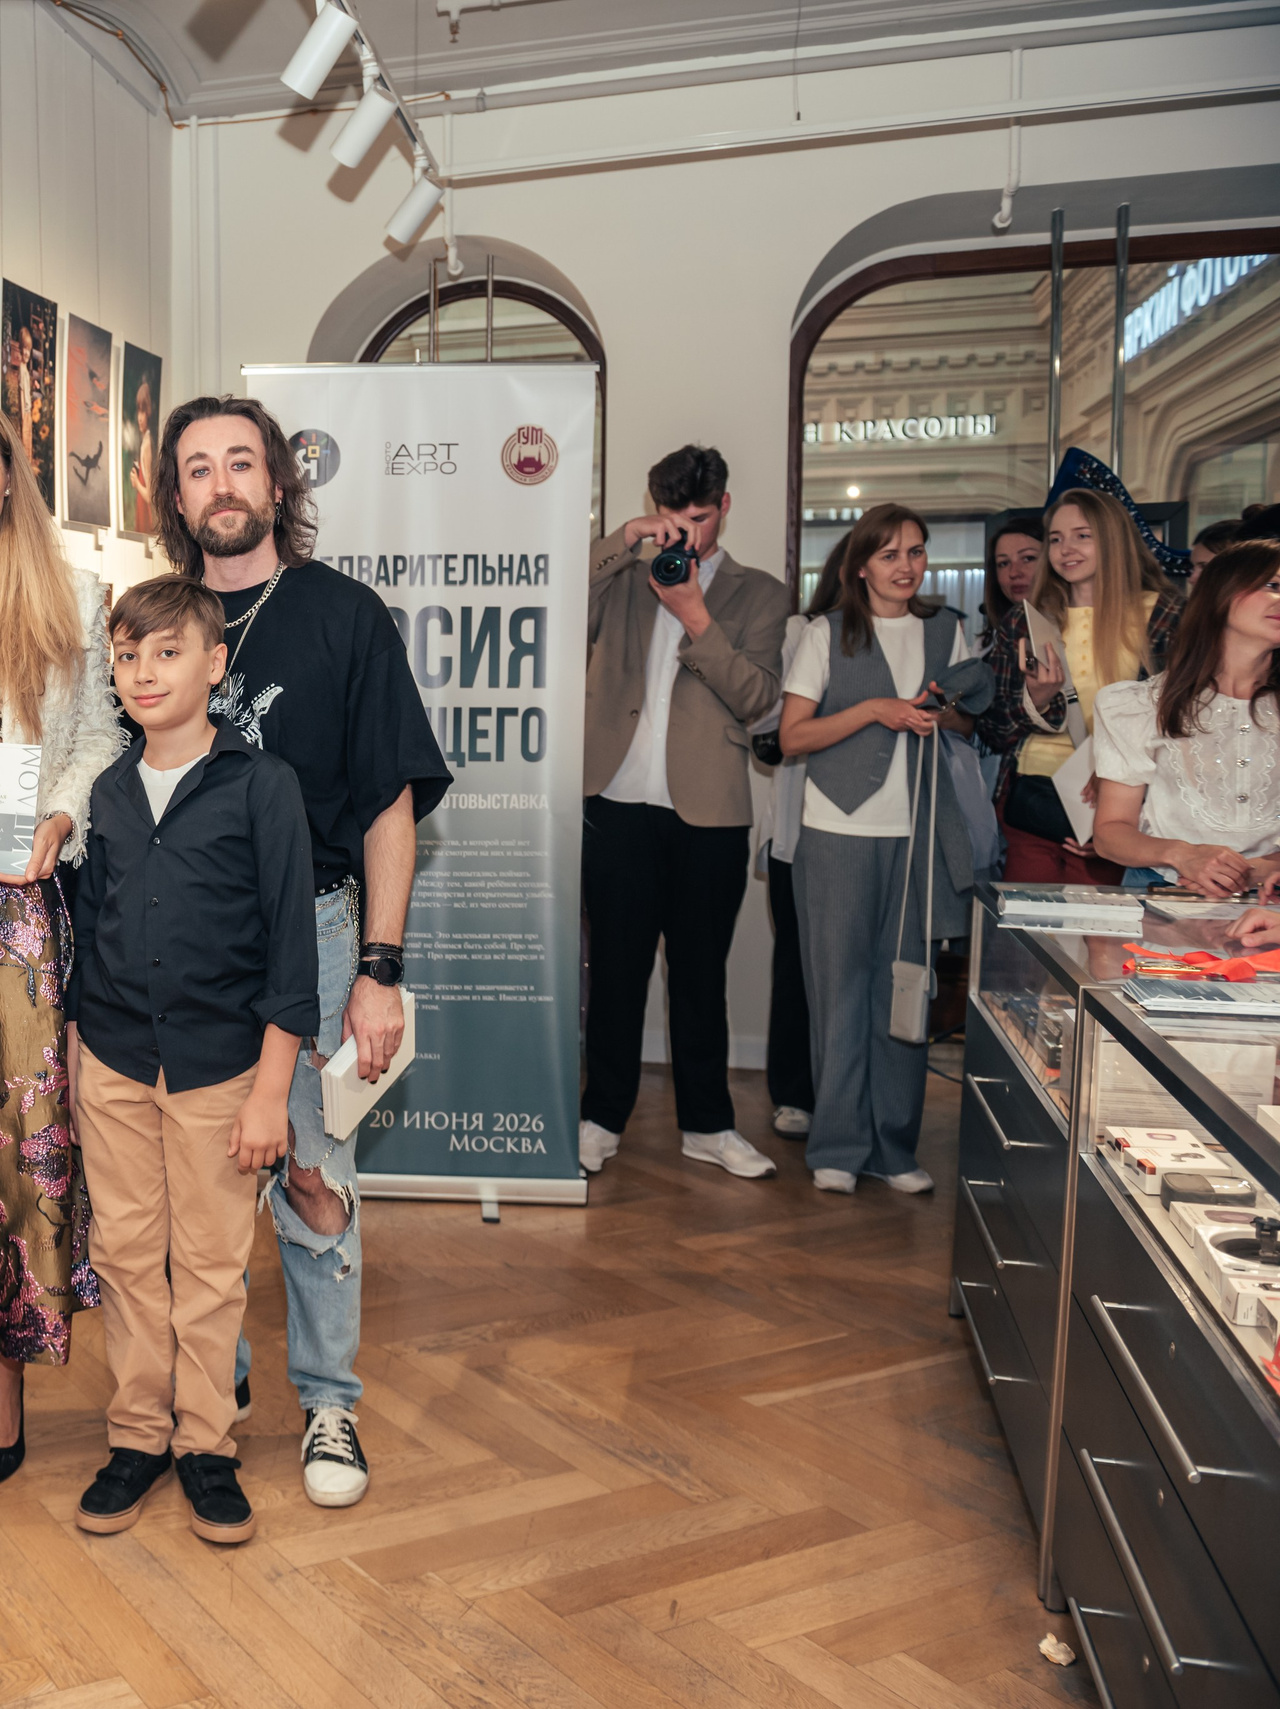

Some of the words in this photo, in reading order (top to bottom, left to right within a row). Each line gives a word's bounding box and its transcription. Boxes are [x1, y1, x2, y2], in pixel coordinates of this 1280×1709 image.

[517, 426, 543, 446] ГУМ
[836, 414, 996, 442] КРАСОТЫ
[392, 443, 459, 461] ART
[391, 461, 457, 475] EXPO
[320, 554, 549, 587] ДВАРИТЕЛЬНАЯ
[440, 793, 548, 810] ОТОВЫСТАВКА
[369, 1110, 395, 1129] 20
[403, 1110, 484, 1132] ИЮНЯ
[492, 1113, 545, 1133] 2026
[449, 1134, 547, 1155] МОСКВА
